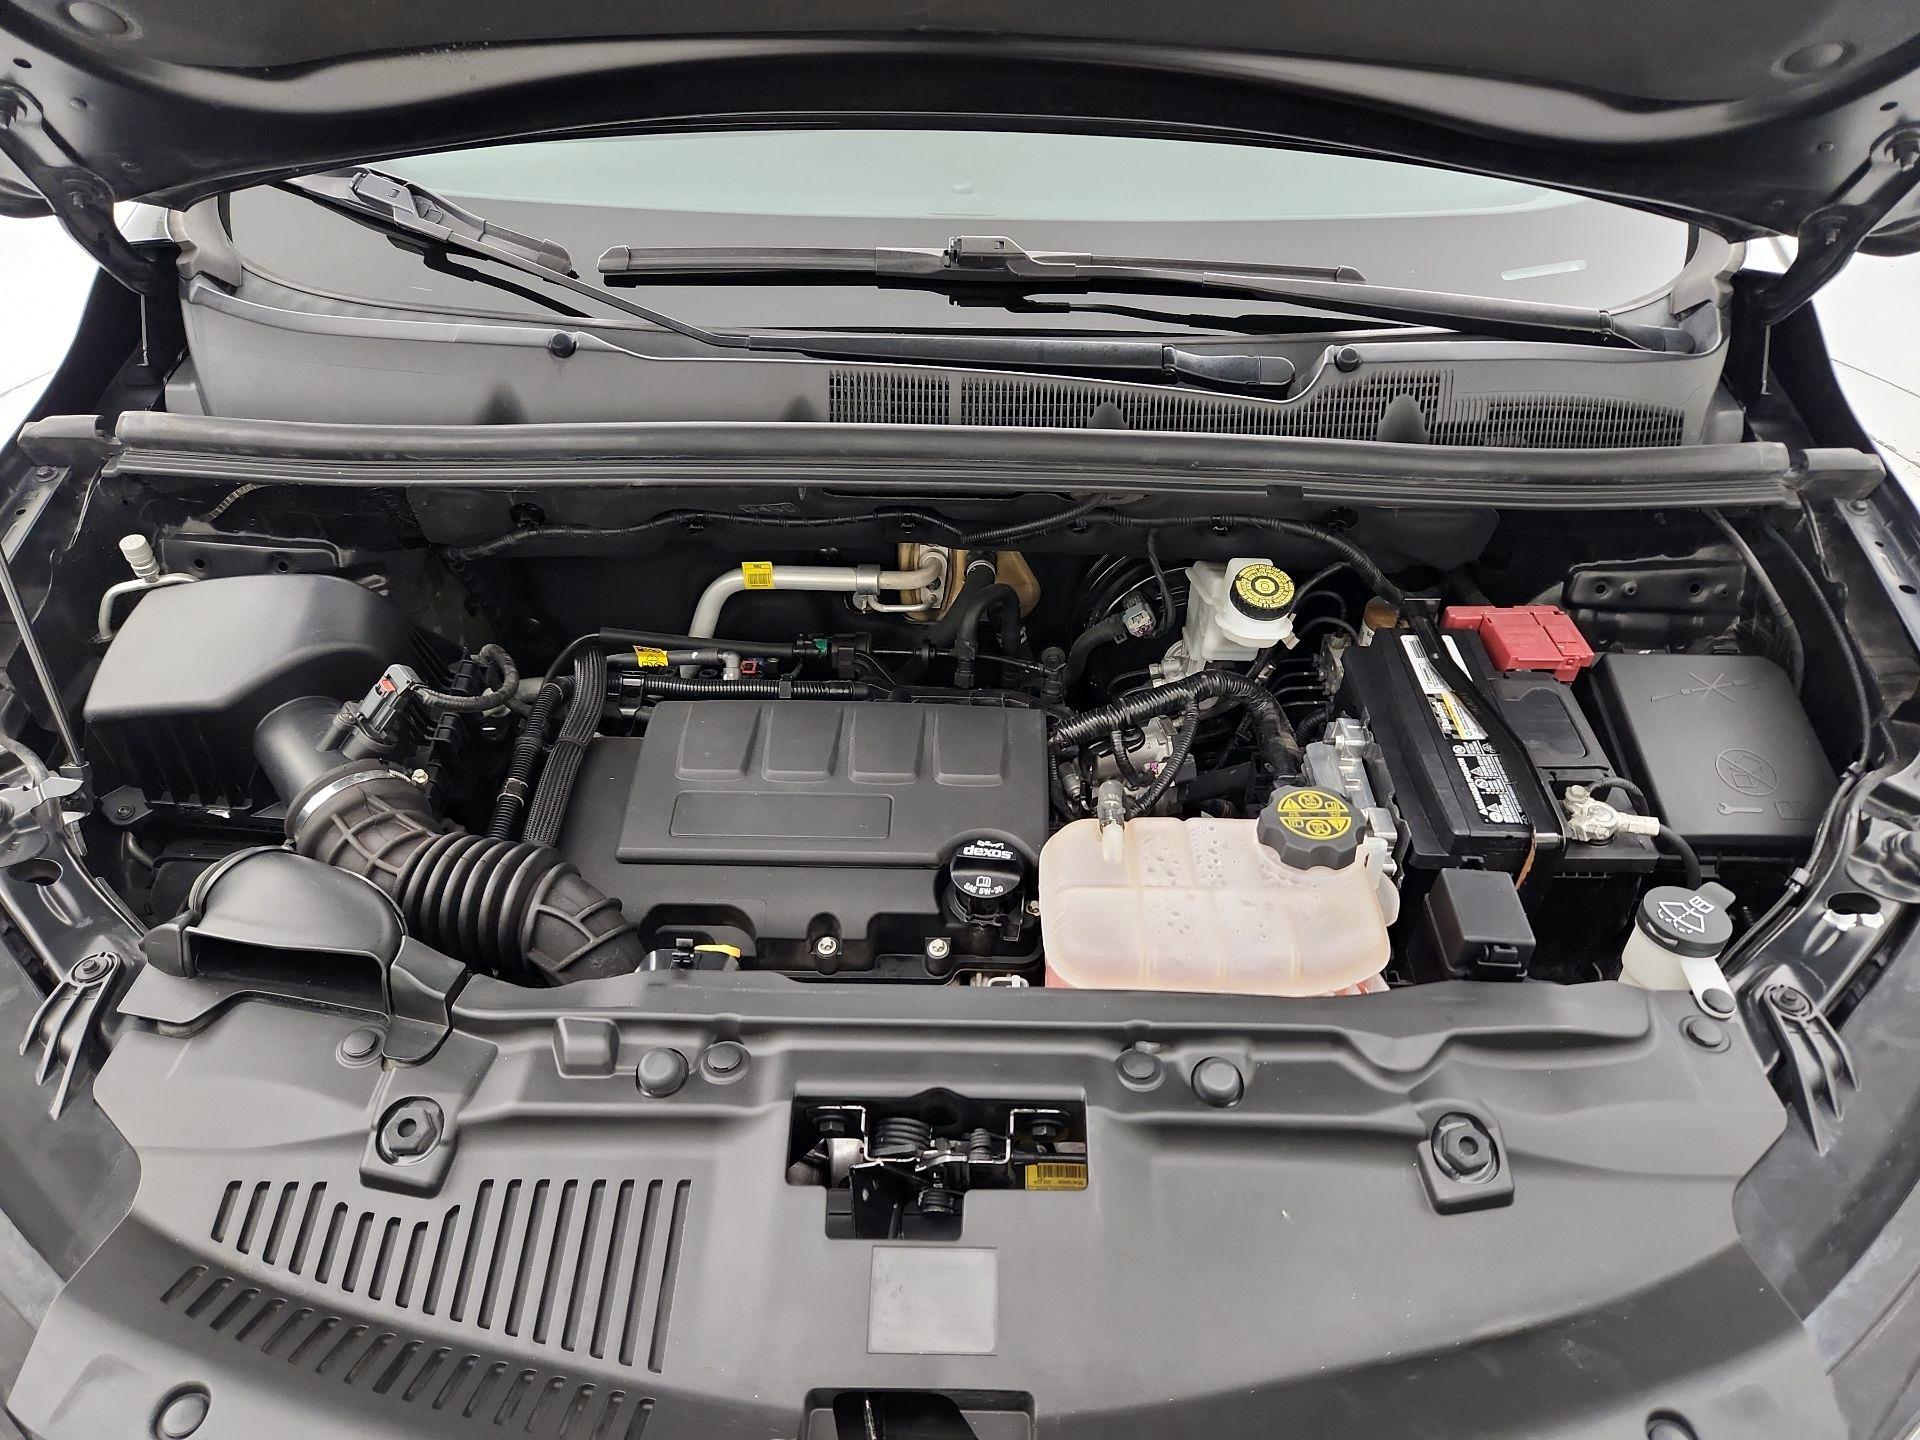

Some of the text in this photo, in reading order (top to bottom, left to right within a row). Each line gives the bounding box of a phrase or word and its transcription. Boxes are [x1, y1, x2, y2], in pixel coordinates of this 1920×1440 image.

[963, 845, 1013, 859] dexos
[964, 882, 1003, 895] SAE 5W-30
